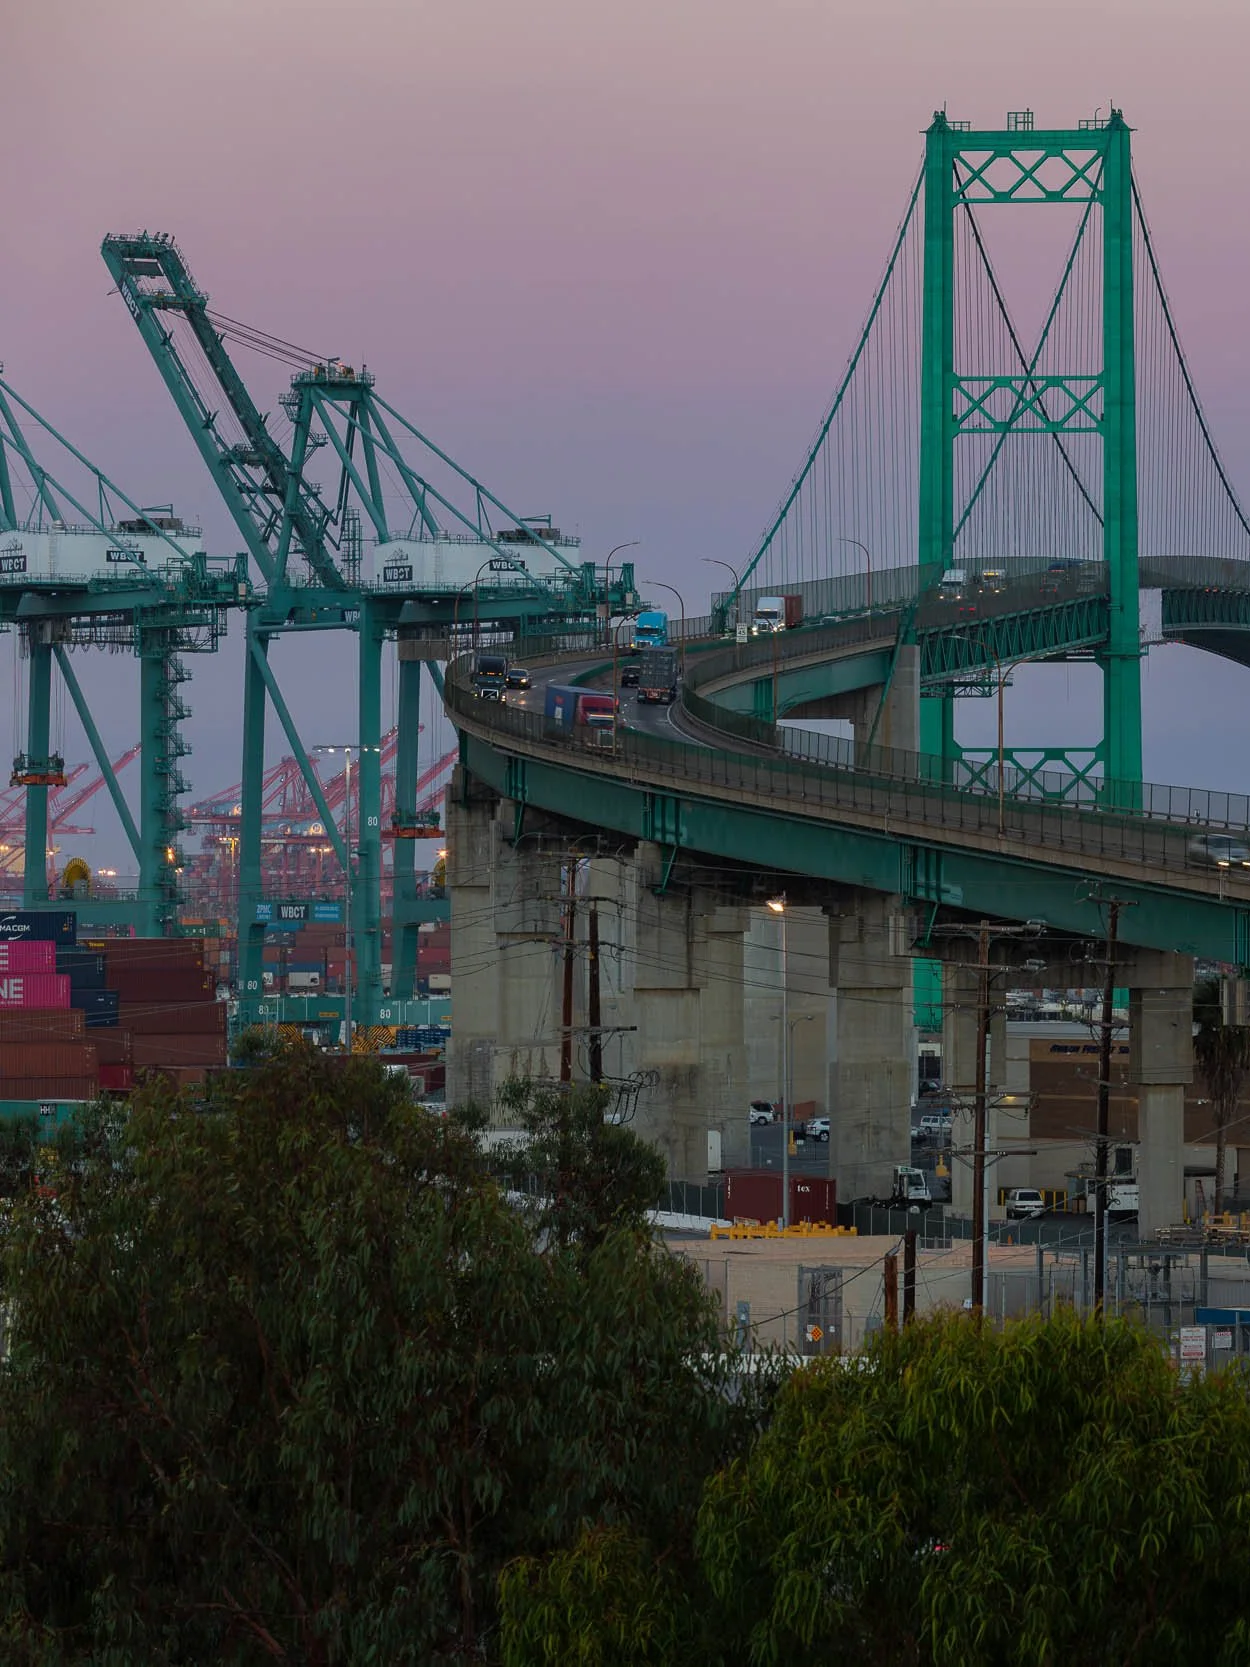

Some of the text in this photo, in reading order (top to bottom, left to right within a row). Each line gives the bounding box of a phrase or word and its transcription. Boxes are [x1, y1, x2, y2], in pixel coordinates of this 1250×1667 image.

[121, 281, 140, 318] WBCT
[1, 557, 25, 572] WBCT
[385, 567, 410, 581] WBCT
[367, 816, 378, 827] 80
[279, 906, 305, 919] WBCT
[247, 980, 258, 990] 80
[379, 1008, 391, 1019] 80
[797, 1184, 811, 1193] tex
